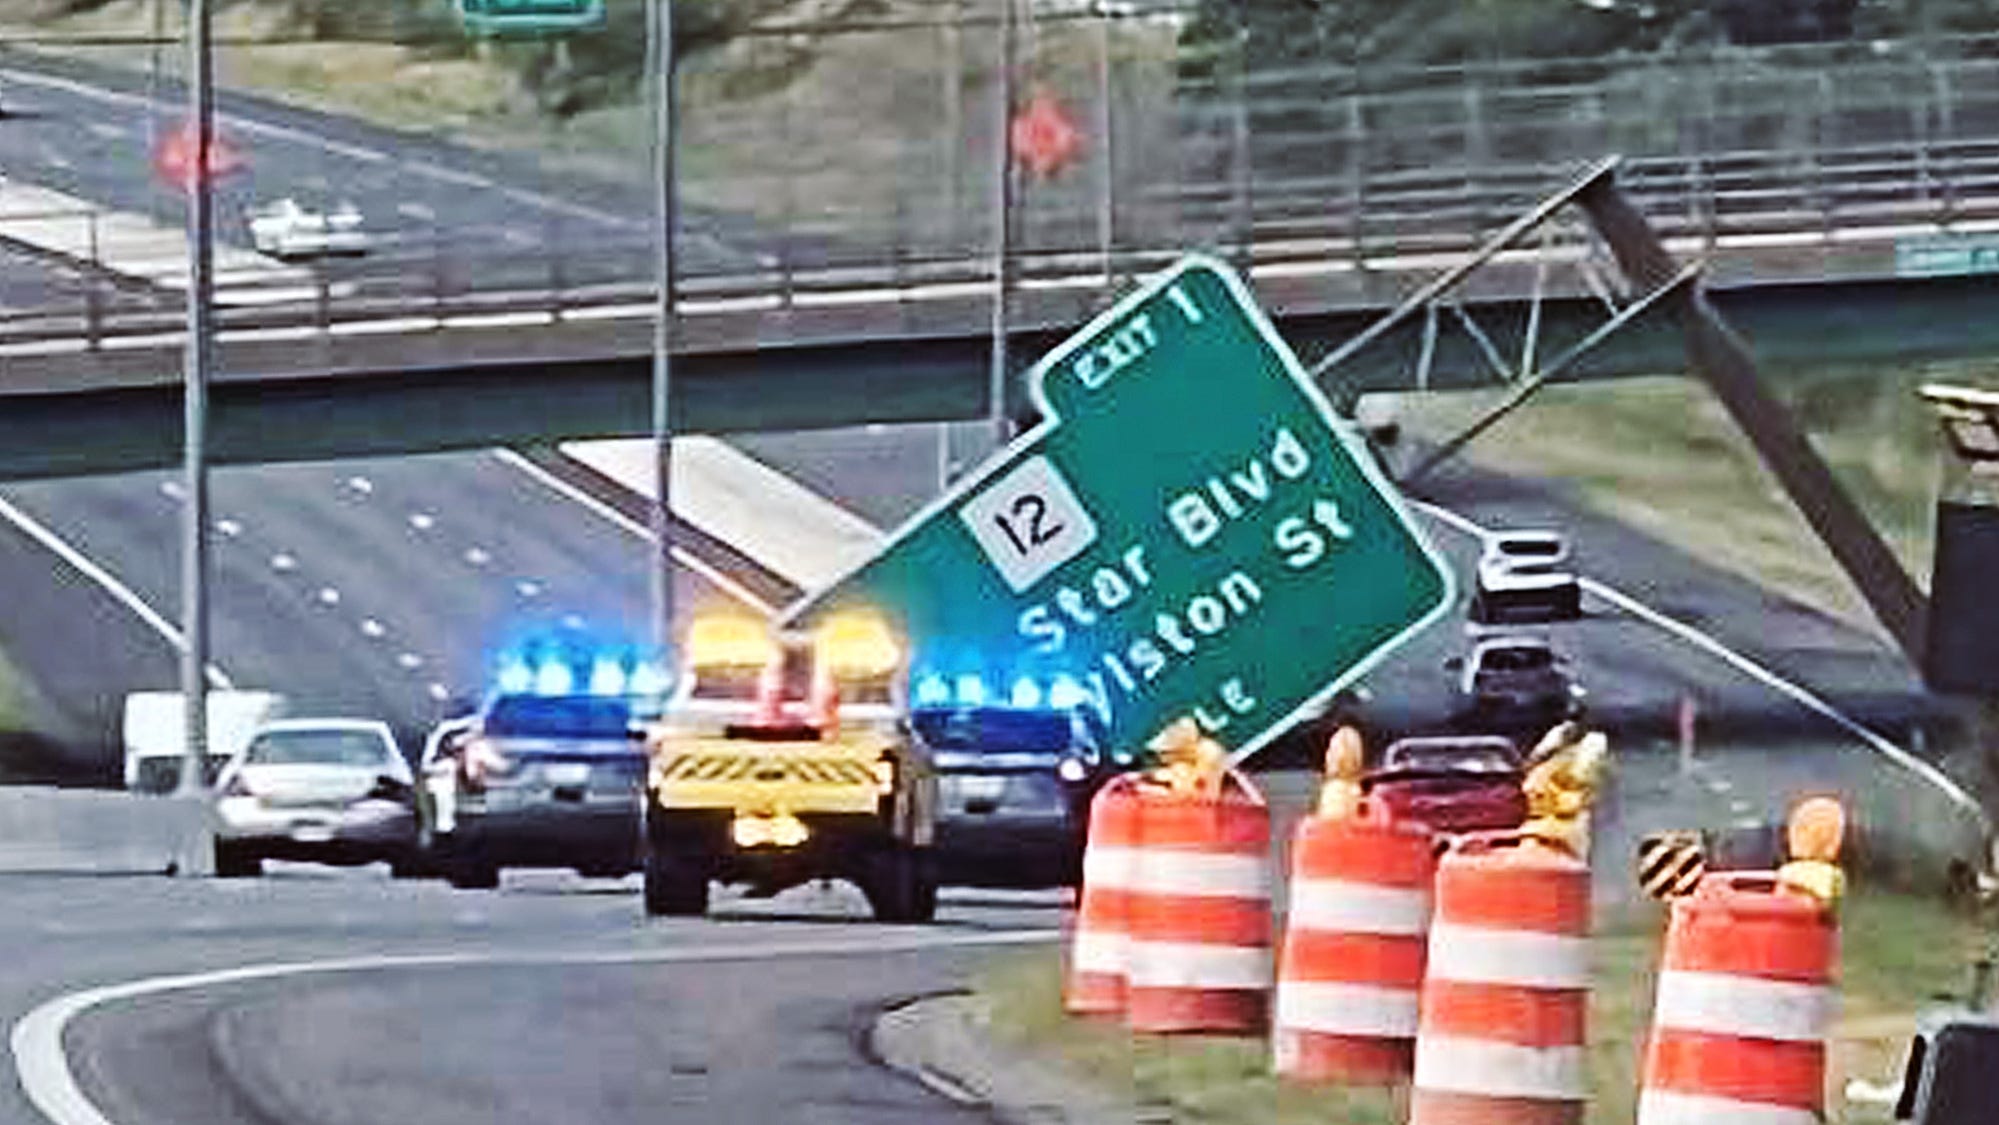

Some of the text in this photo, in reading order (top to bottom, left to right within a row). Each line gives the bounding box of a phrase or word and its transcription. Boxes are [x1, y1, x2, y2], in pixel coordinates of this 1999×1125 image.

[1073, 284, 1203, 390] EXIT 1
[994, 494, 1065, 556] 12
[1018, 427, 1311, 653] Star Blvd
[1274, 498, 1354, 567] St
